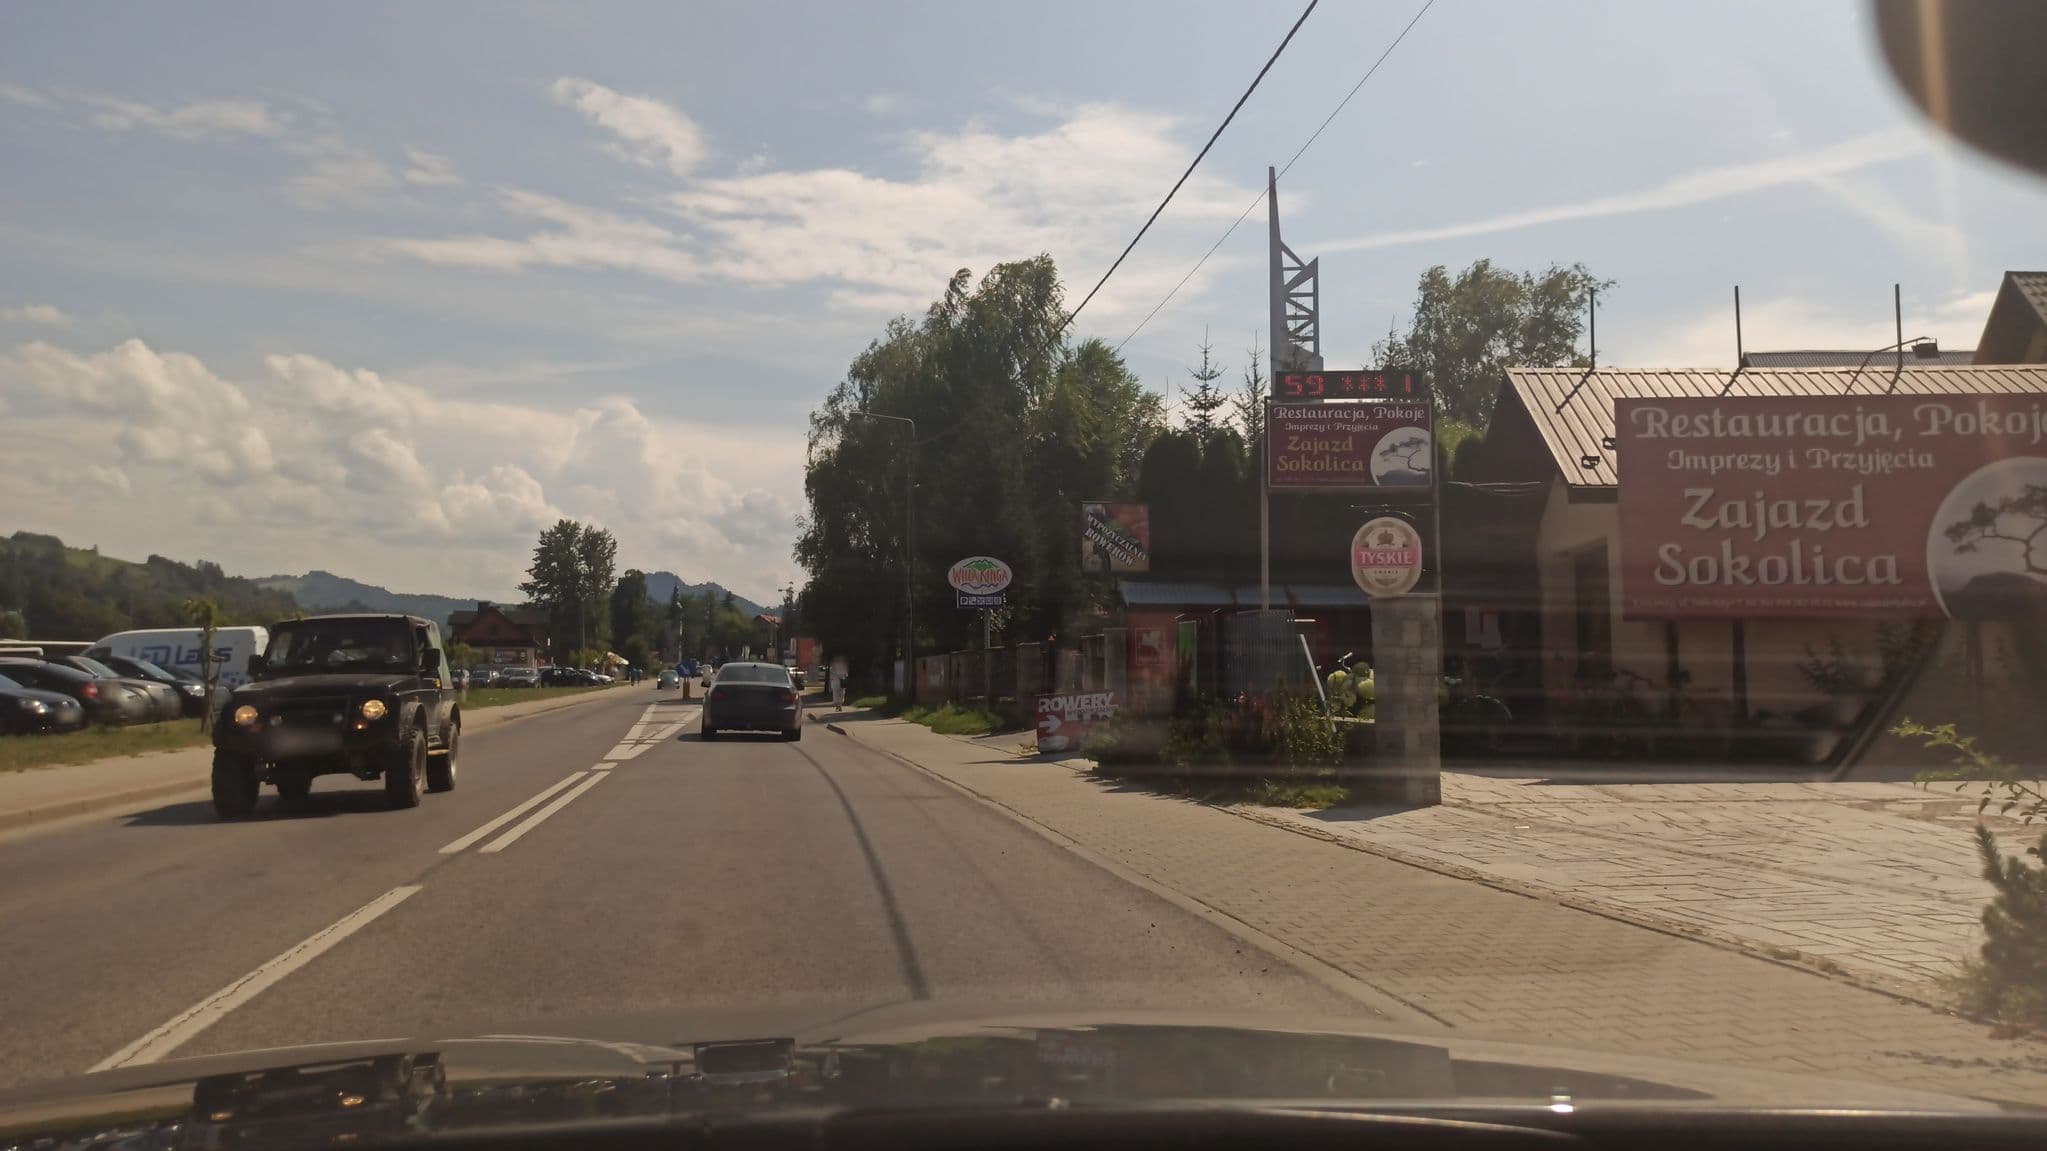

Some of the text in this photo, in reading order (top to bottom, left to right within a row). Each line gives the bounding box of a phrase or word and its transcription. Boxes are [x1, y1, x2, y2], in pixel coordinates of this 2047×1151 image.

[1274, 406, 1425, 422] Restauracja, Pokoje
[1631, 400, 2047, 446] Restauracja, Pokoj
[1287, 435, 1353, 456] Zajazd
[1277, 454, 1366, 472] Sokolica
[1667, 447, 1935, 475] Imprezy i Przyjęcia
[1680, 484, 1870, 542] Zajazd
[1653, 538, 1903, 587] Sokolica
[953, 567, 1009, 584] WILLA KINGA
[1038, 691, 1115, 713] ROWERY
